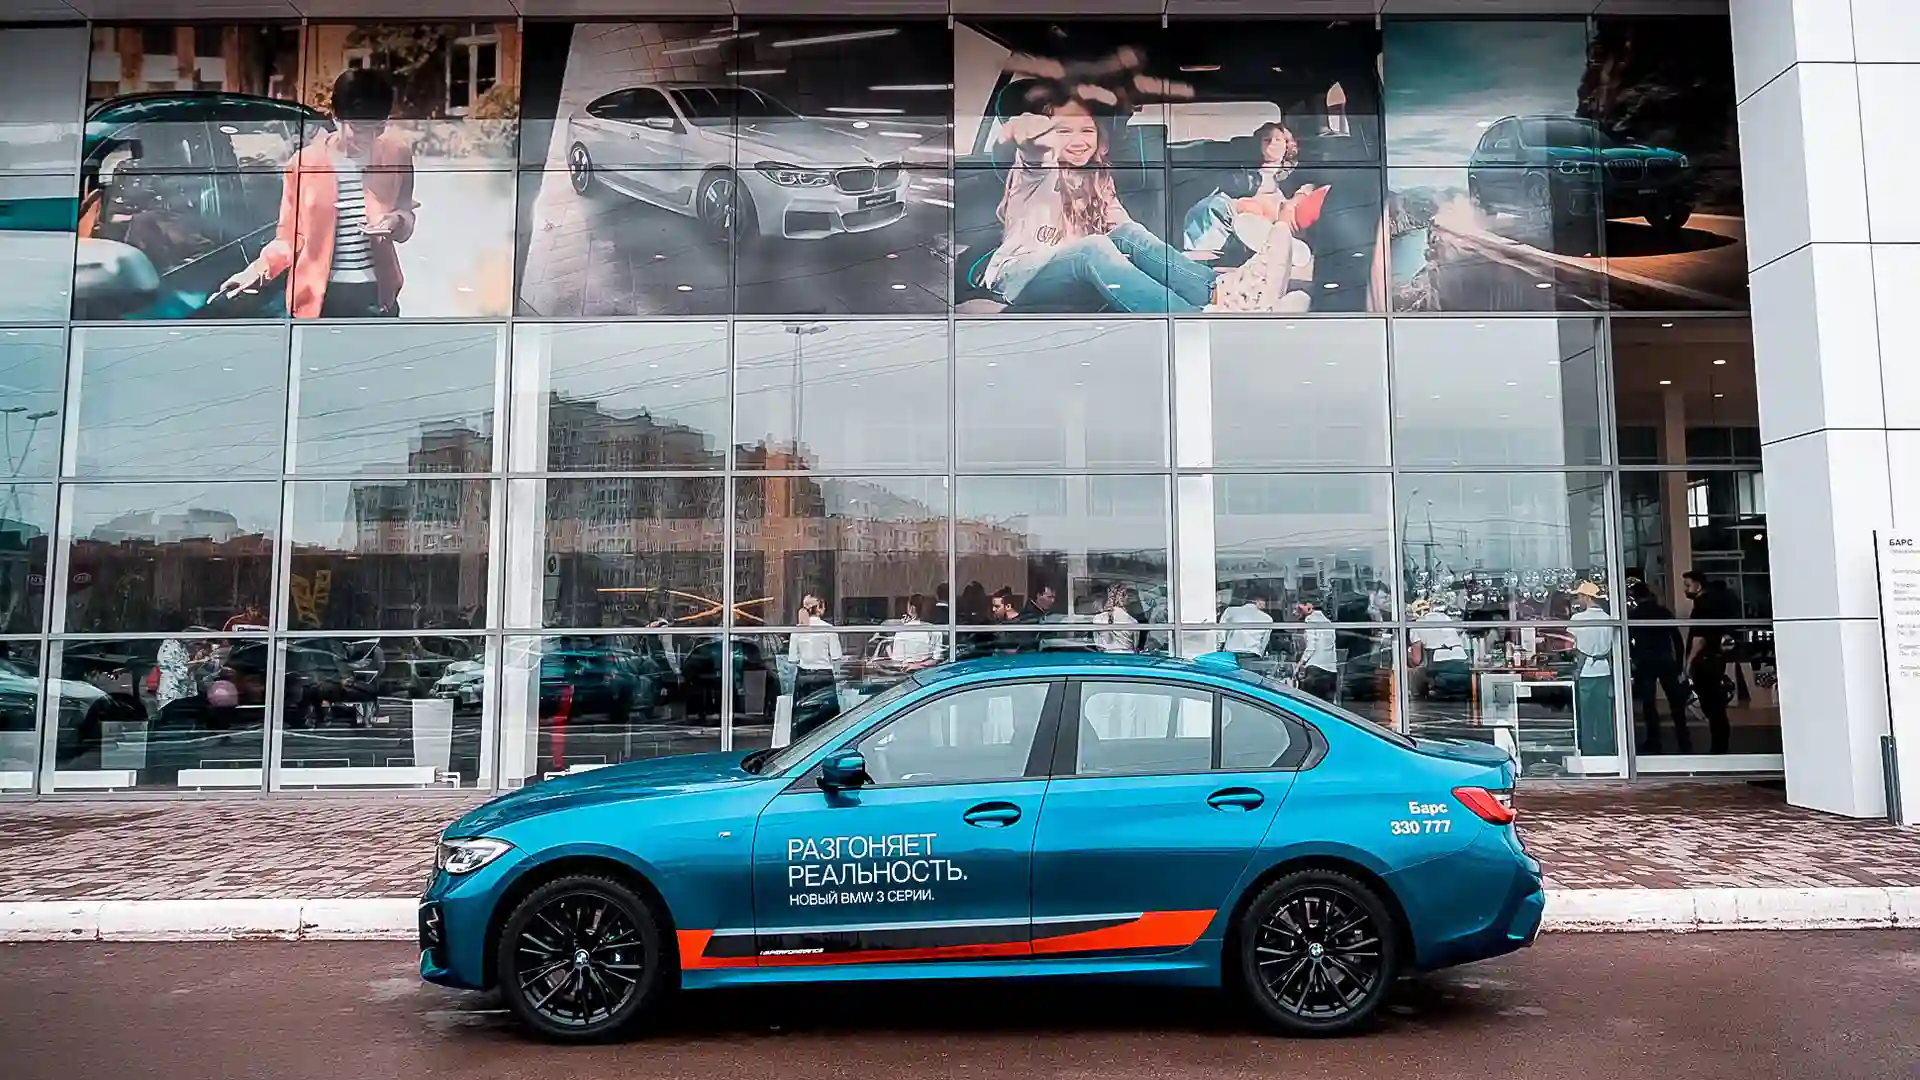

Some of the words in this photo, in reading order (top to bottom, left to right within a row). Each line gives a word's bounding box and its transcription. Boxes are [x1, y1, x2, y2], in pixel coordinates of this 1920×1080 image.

[1889, 538, 1913, 546] БАРС
[1408, 801, 1449, 817] Барс
[1390, 820, 1420, 835] 330
[1422, 819, 1451, 834] 777
[787, 833, 937, 861] РАЗГОНЯЕТ
[788, 859, 968, 888] РЕАЛЬНОСТЬ.
[789, 890, 838, 906] НОВЫЙ
[840, 891, 874, 905] BMW
[876, 890, 885, 903] 3
[887, 889, 935, 903] СЕРИИ.
